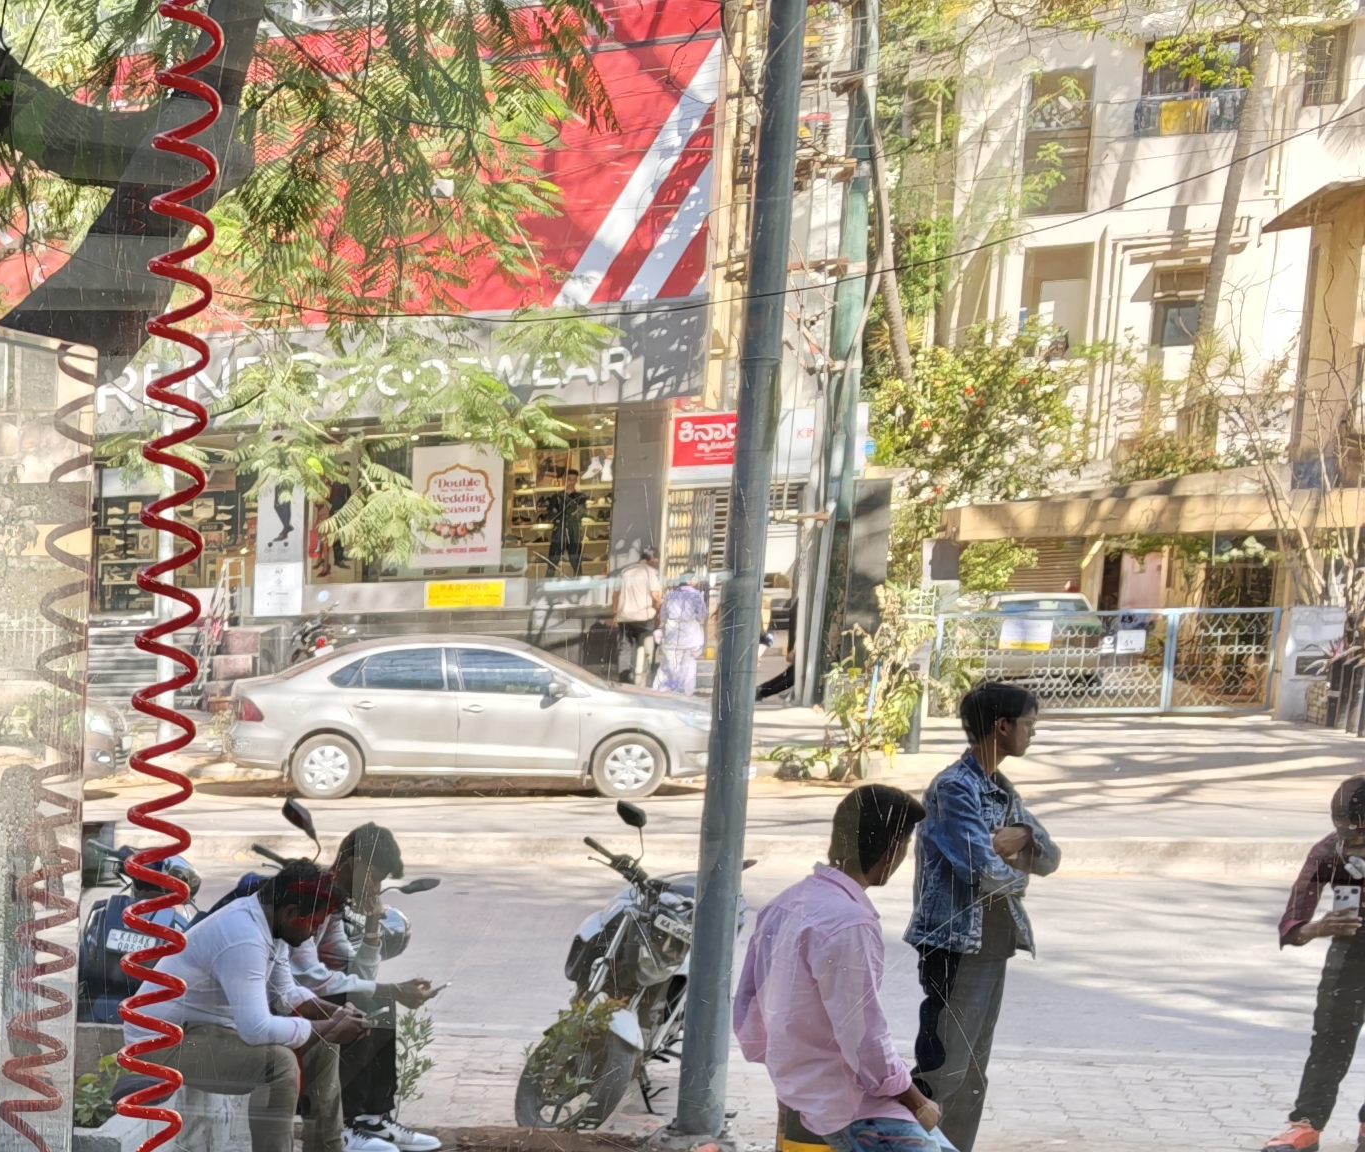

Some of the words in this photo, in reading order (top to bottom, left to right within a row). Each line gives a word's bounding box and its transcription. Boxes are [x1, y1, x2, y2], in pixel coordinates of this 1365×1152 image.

[434, 477, 481, 488] Double
[432, 493, 487, 504] Wedding
[442, 505, 481, 514] eason
